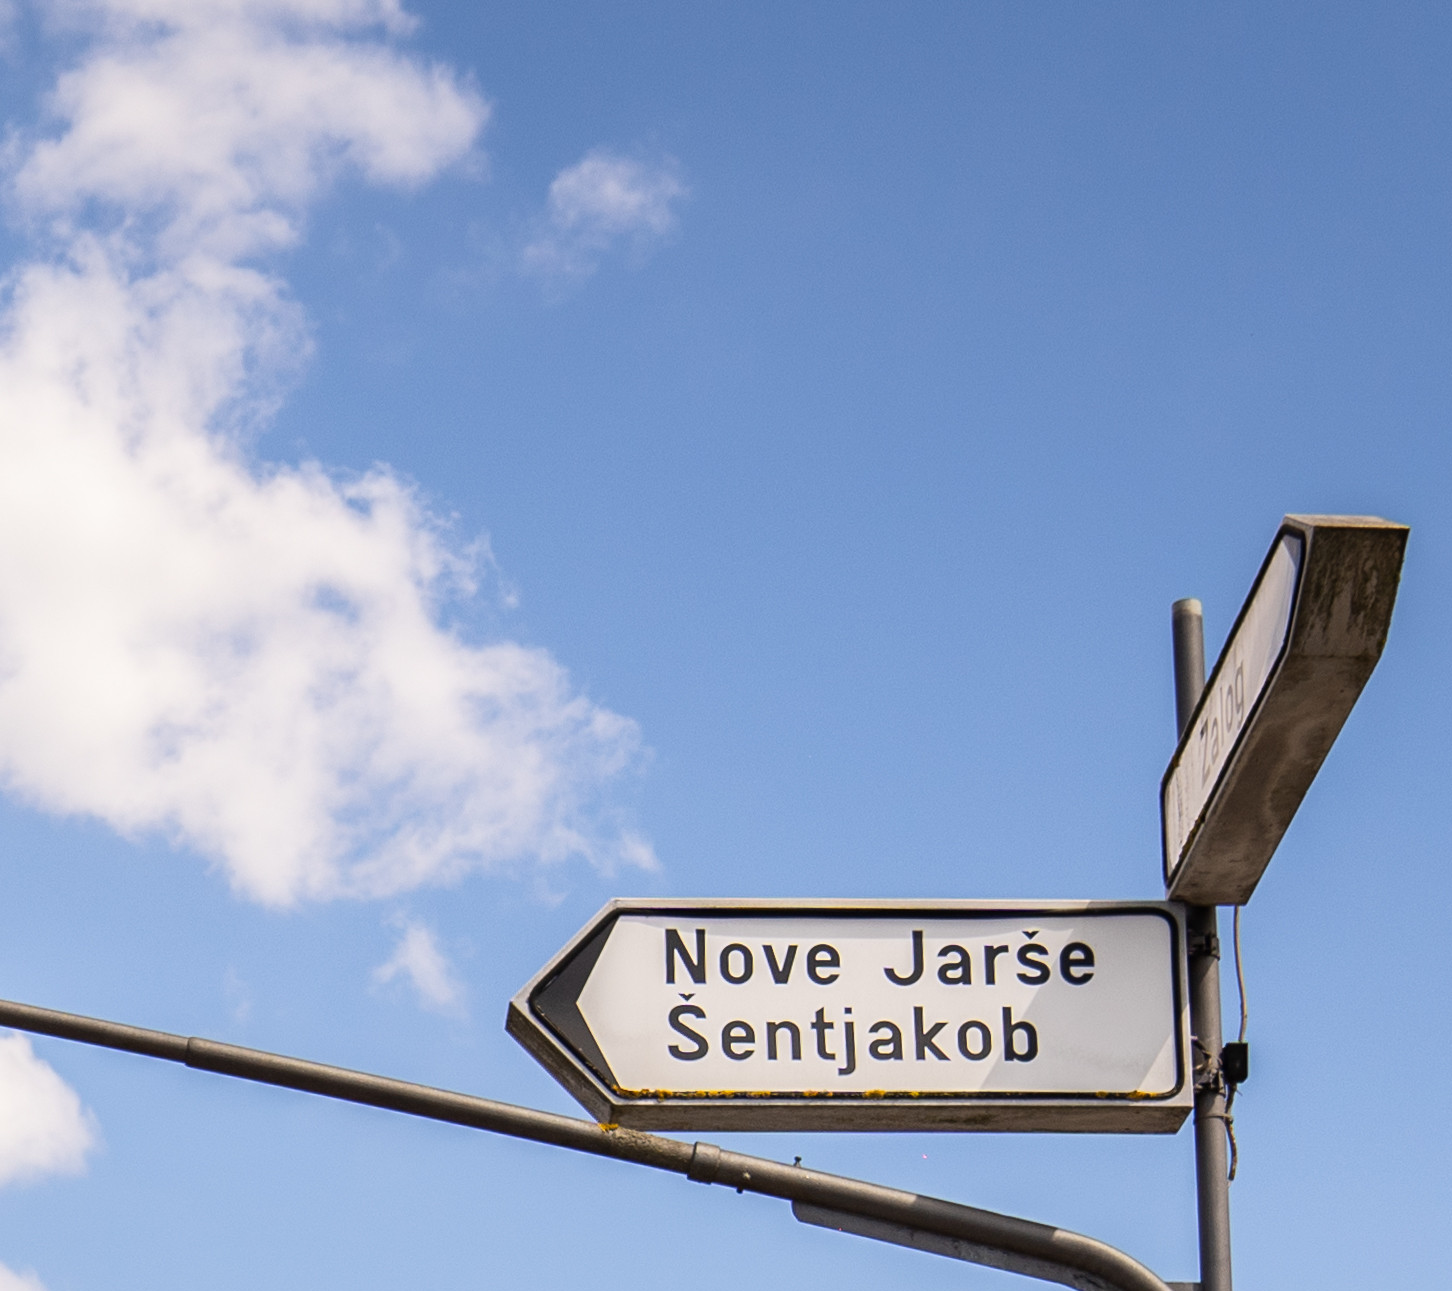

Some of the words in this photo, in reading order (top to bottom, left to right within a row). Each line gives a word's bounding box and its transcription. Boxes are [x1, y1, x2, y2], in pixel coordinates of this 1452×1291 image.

[1200, 658, 1244, 790] Zalog
[664, 928, 842, 986] Nove
[883, 929, 1097, 987] Jarše
[666, 993, 1041, 1077] Šentjakob
